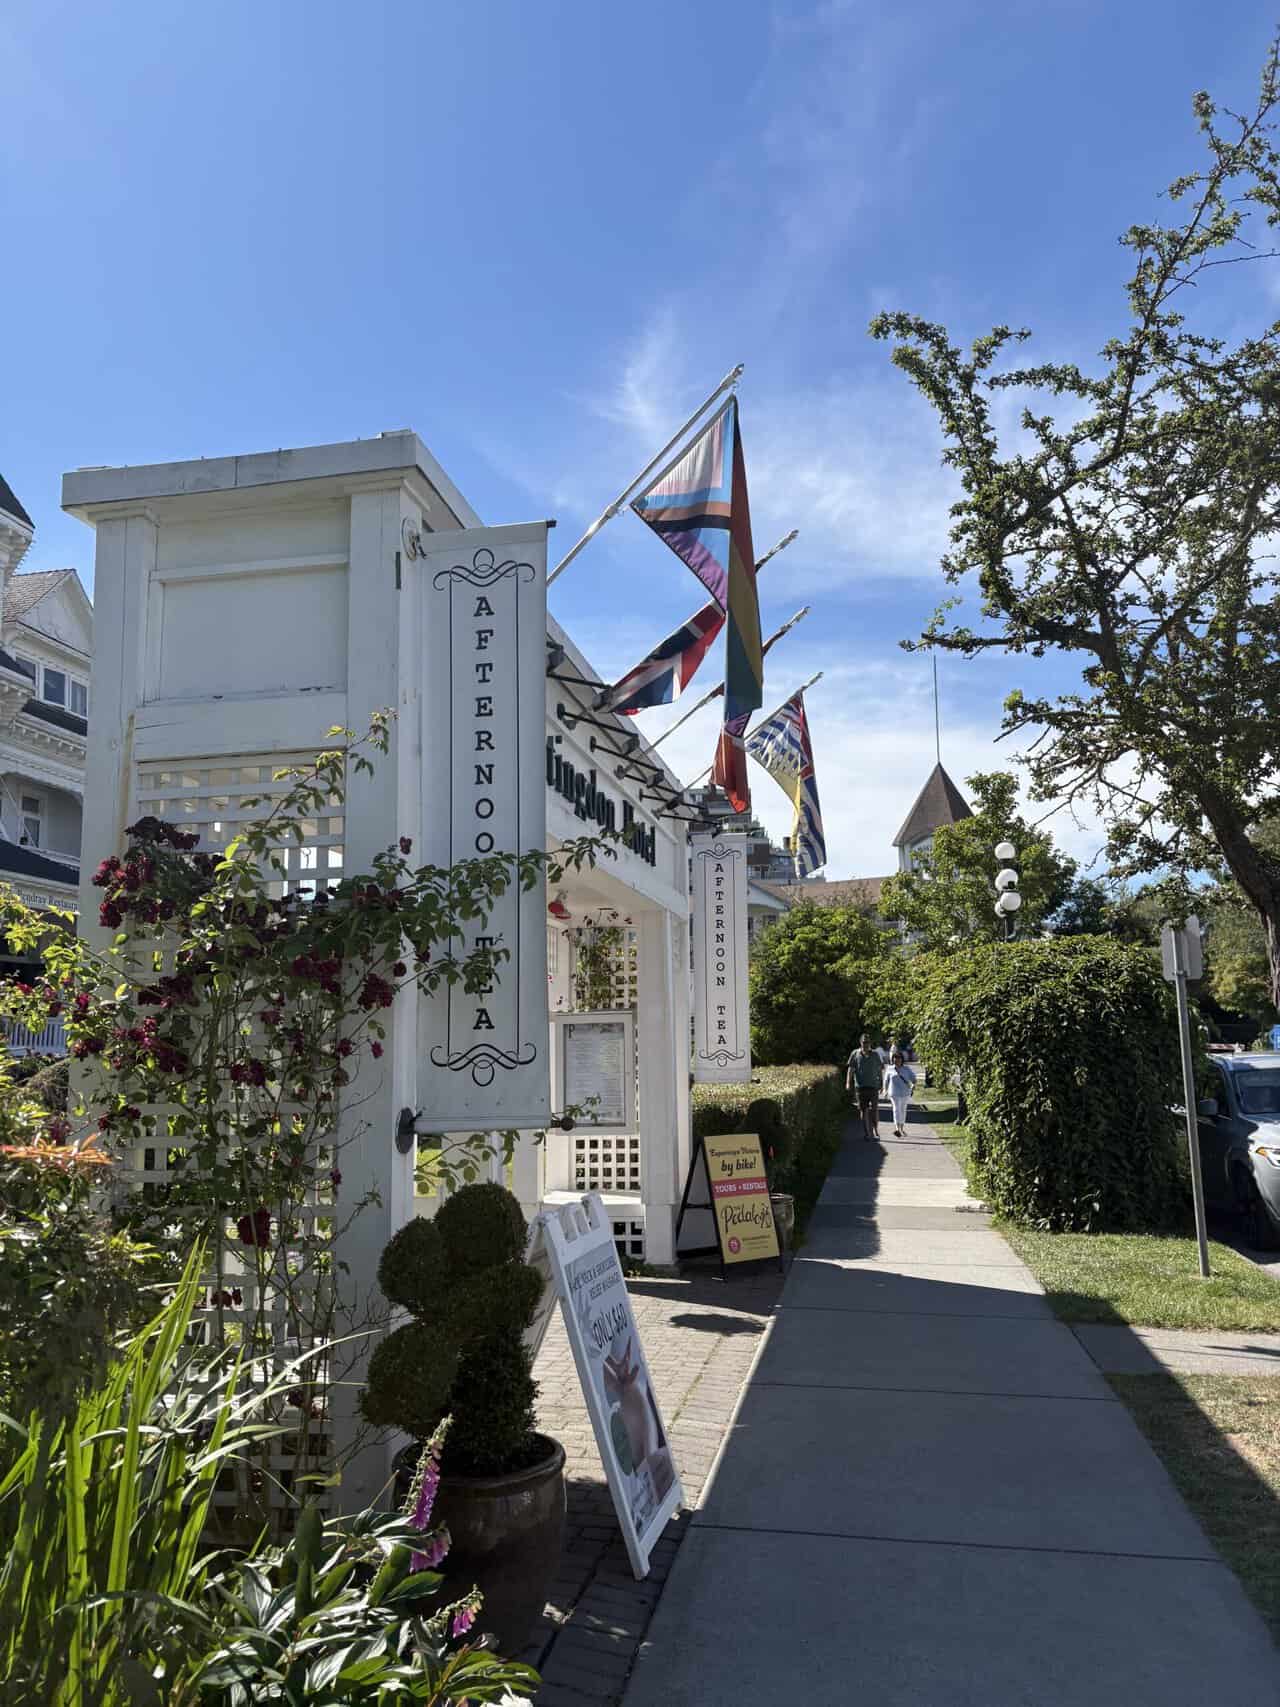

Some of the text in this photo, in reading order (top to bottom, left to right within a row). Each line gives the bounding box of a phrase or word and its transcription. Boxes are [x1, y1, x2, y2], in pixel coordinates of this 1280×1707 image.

[474, 596, 496, 886] AFTERNOO
[714, 863, 727, 1045] AFTERNOON TEA
